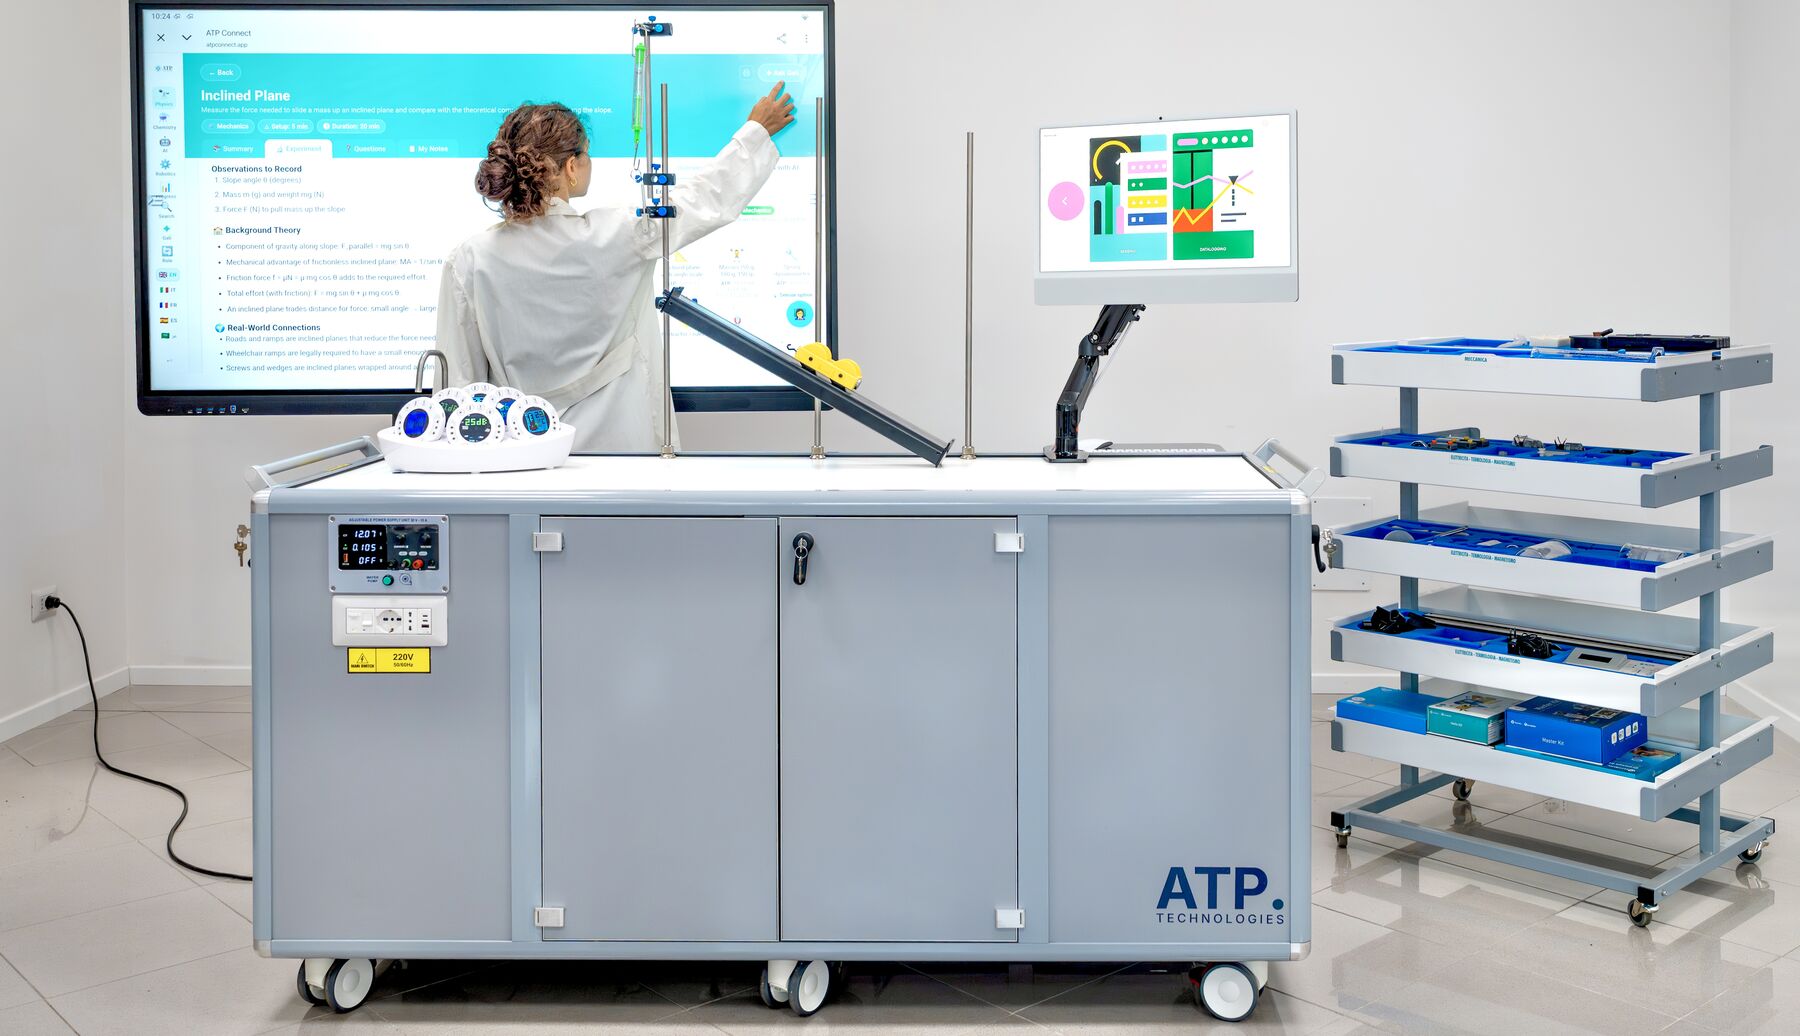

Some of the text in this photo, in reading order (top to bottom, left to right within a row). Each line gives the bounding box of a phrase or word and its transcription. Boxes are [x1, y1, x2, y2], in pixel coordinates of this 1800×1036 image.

[201, 90, 291, 101] Inclined Plane
[377, 106, 395, 114] plane
[223, 145, 254, 153] Summary
[354, 144, 386, 152] Questions
[418, 145, 429, 153] My
[211, 165, 263, 173] Observations
[275, 165, 302, 173] Record
[269, 177, 302, 185] (degrees)
[277, 191, 300, 199] weight
[225, 226, 301, 235] Background Theory
[225, 243, 265, 251] Component
[275, 243, 298, 251] gravity
[299, 242, 318, 251] along
[226, 258, 265, 266] Mechanical
[267, 259, 301, 267] advantage
[378, 274, 406, 282] required
[246, 289, 265, 297] effort
[266, 305, 285, 313] plane
[391, 305, 409, 313] angle
[227, 324, 321, 332] Real-World Connections
[326, 335, 348, 343] planes
[300, 350, 321, 358] legally
[322, 350, 350, 358] required
[267, 364, 293, 372] wedges
[334, 363, 357, 372] planes
[358, 363, 387, 372] wrapped
[389, 363, 412, 371] around
[358, 556, 377, 566] OFF
[393, 654, 414, 662] 220V
[1156, 912, 1285, 925] TECHNOLOGIES
